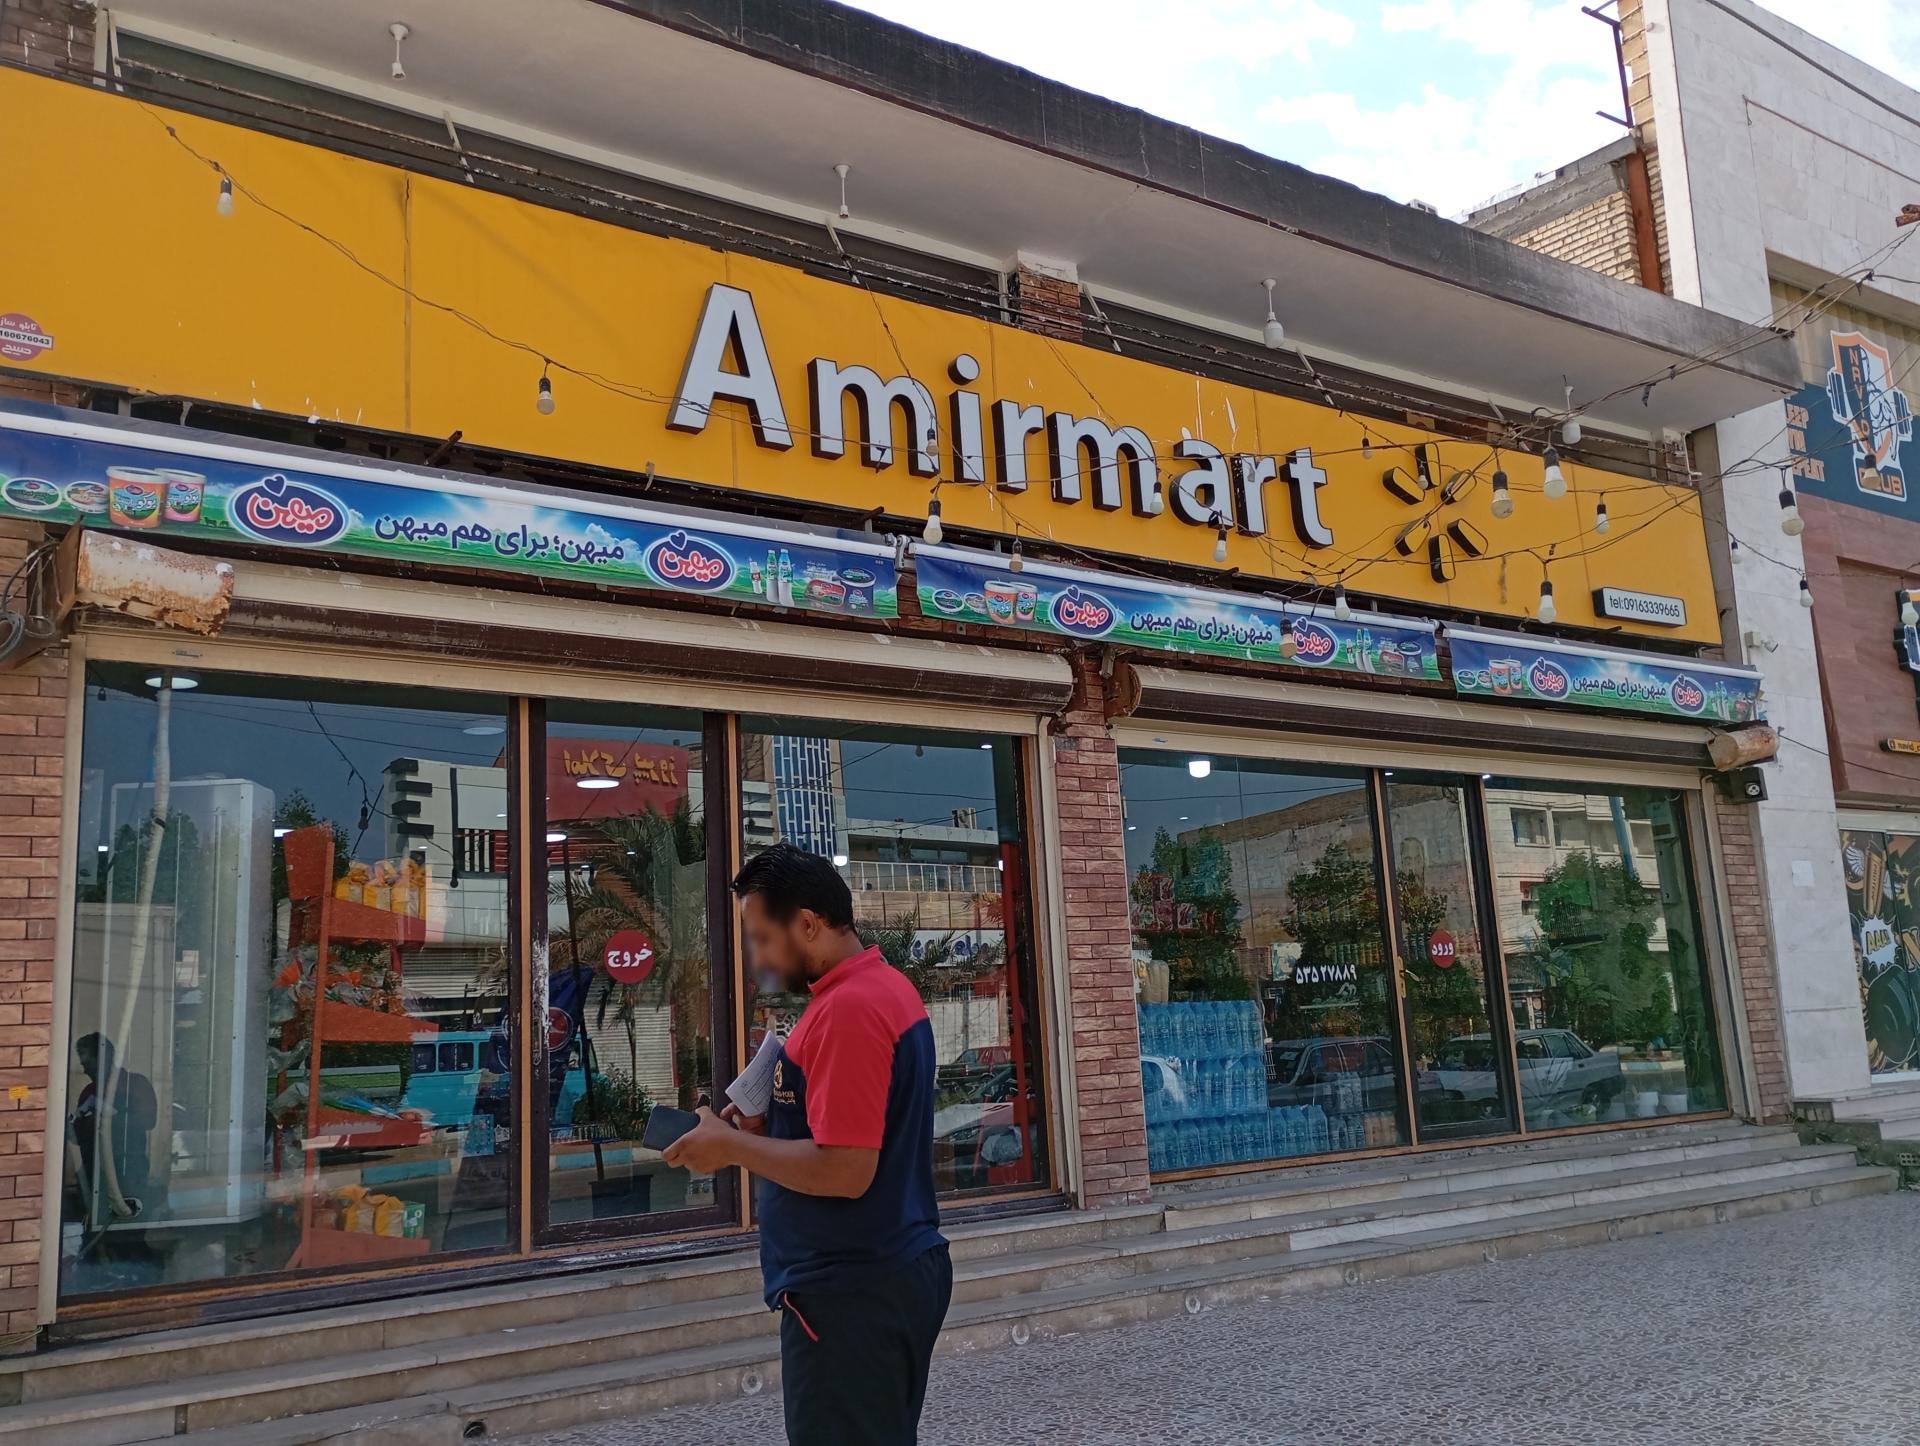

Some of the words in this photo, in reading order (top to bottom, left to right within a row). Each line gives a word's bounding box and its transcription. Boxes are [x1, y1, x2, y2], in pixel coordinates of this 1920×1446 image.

[665, 281, 1334, 548] Amirmart
[247, 490, 333, 534] میهن
[375, 513, 447, 542] میهن
[451, 522, 491, 549] هم
[494, 524, 550, 559] برای
[658, 545, 724, 583] میهن
[1059, 598, 1108, 630] میهن
[1609, 595, 1680, 617] tel:09163339665
[1131, 612, 1171, 632] میهن
[1173, 617, 1197, 637] هم
[1198, 615, 1229, 643] برای
[1533, 668, 1564, 691] میهن
[1572, 677, 1599, 693] میهن
[1601, 680, 1616, 695] هم
[1617, 677, 1638, 698] برای
[607, 942, 653, 968] خروج
[1431, 942, 1454, 956] ورود
